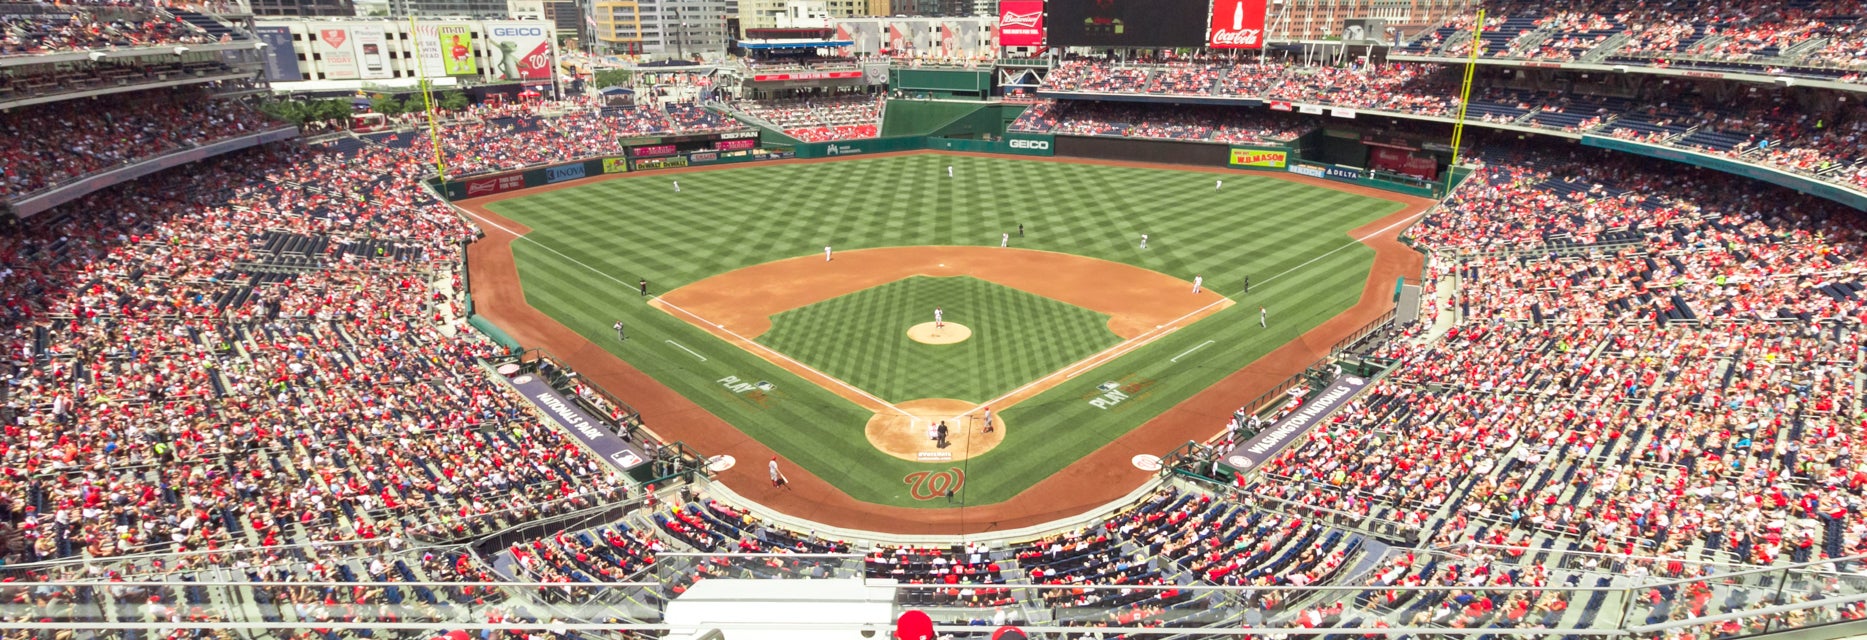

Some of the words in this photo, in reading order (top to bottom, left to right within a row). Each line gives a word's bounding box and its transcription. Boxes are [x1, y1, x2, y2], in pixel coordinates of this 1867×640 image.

[494, 28, 541, 36] GEICO
[1009, 139, 1048, 150] GEICO
[556, 166, 585, 178] INOVA
[1333, 169, 1357, 178] DELTA
[716, 375, 756, 393] PLAY
[1088, 389, 1129, 410] PLAY
[536, 392, 583, 424] NATIONALS
[574, 421, 604, 440] PARK
[1248, 412, 1312, 454] WASHINGTON
[1303, 385, 1351, 417] NATIONALS
